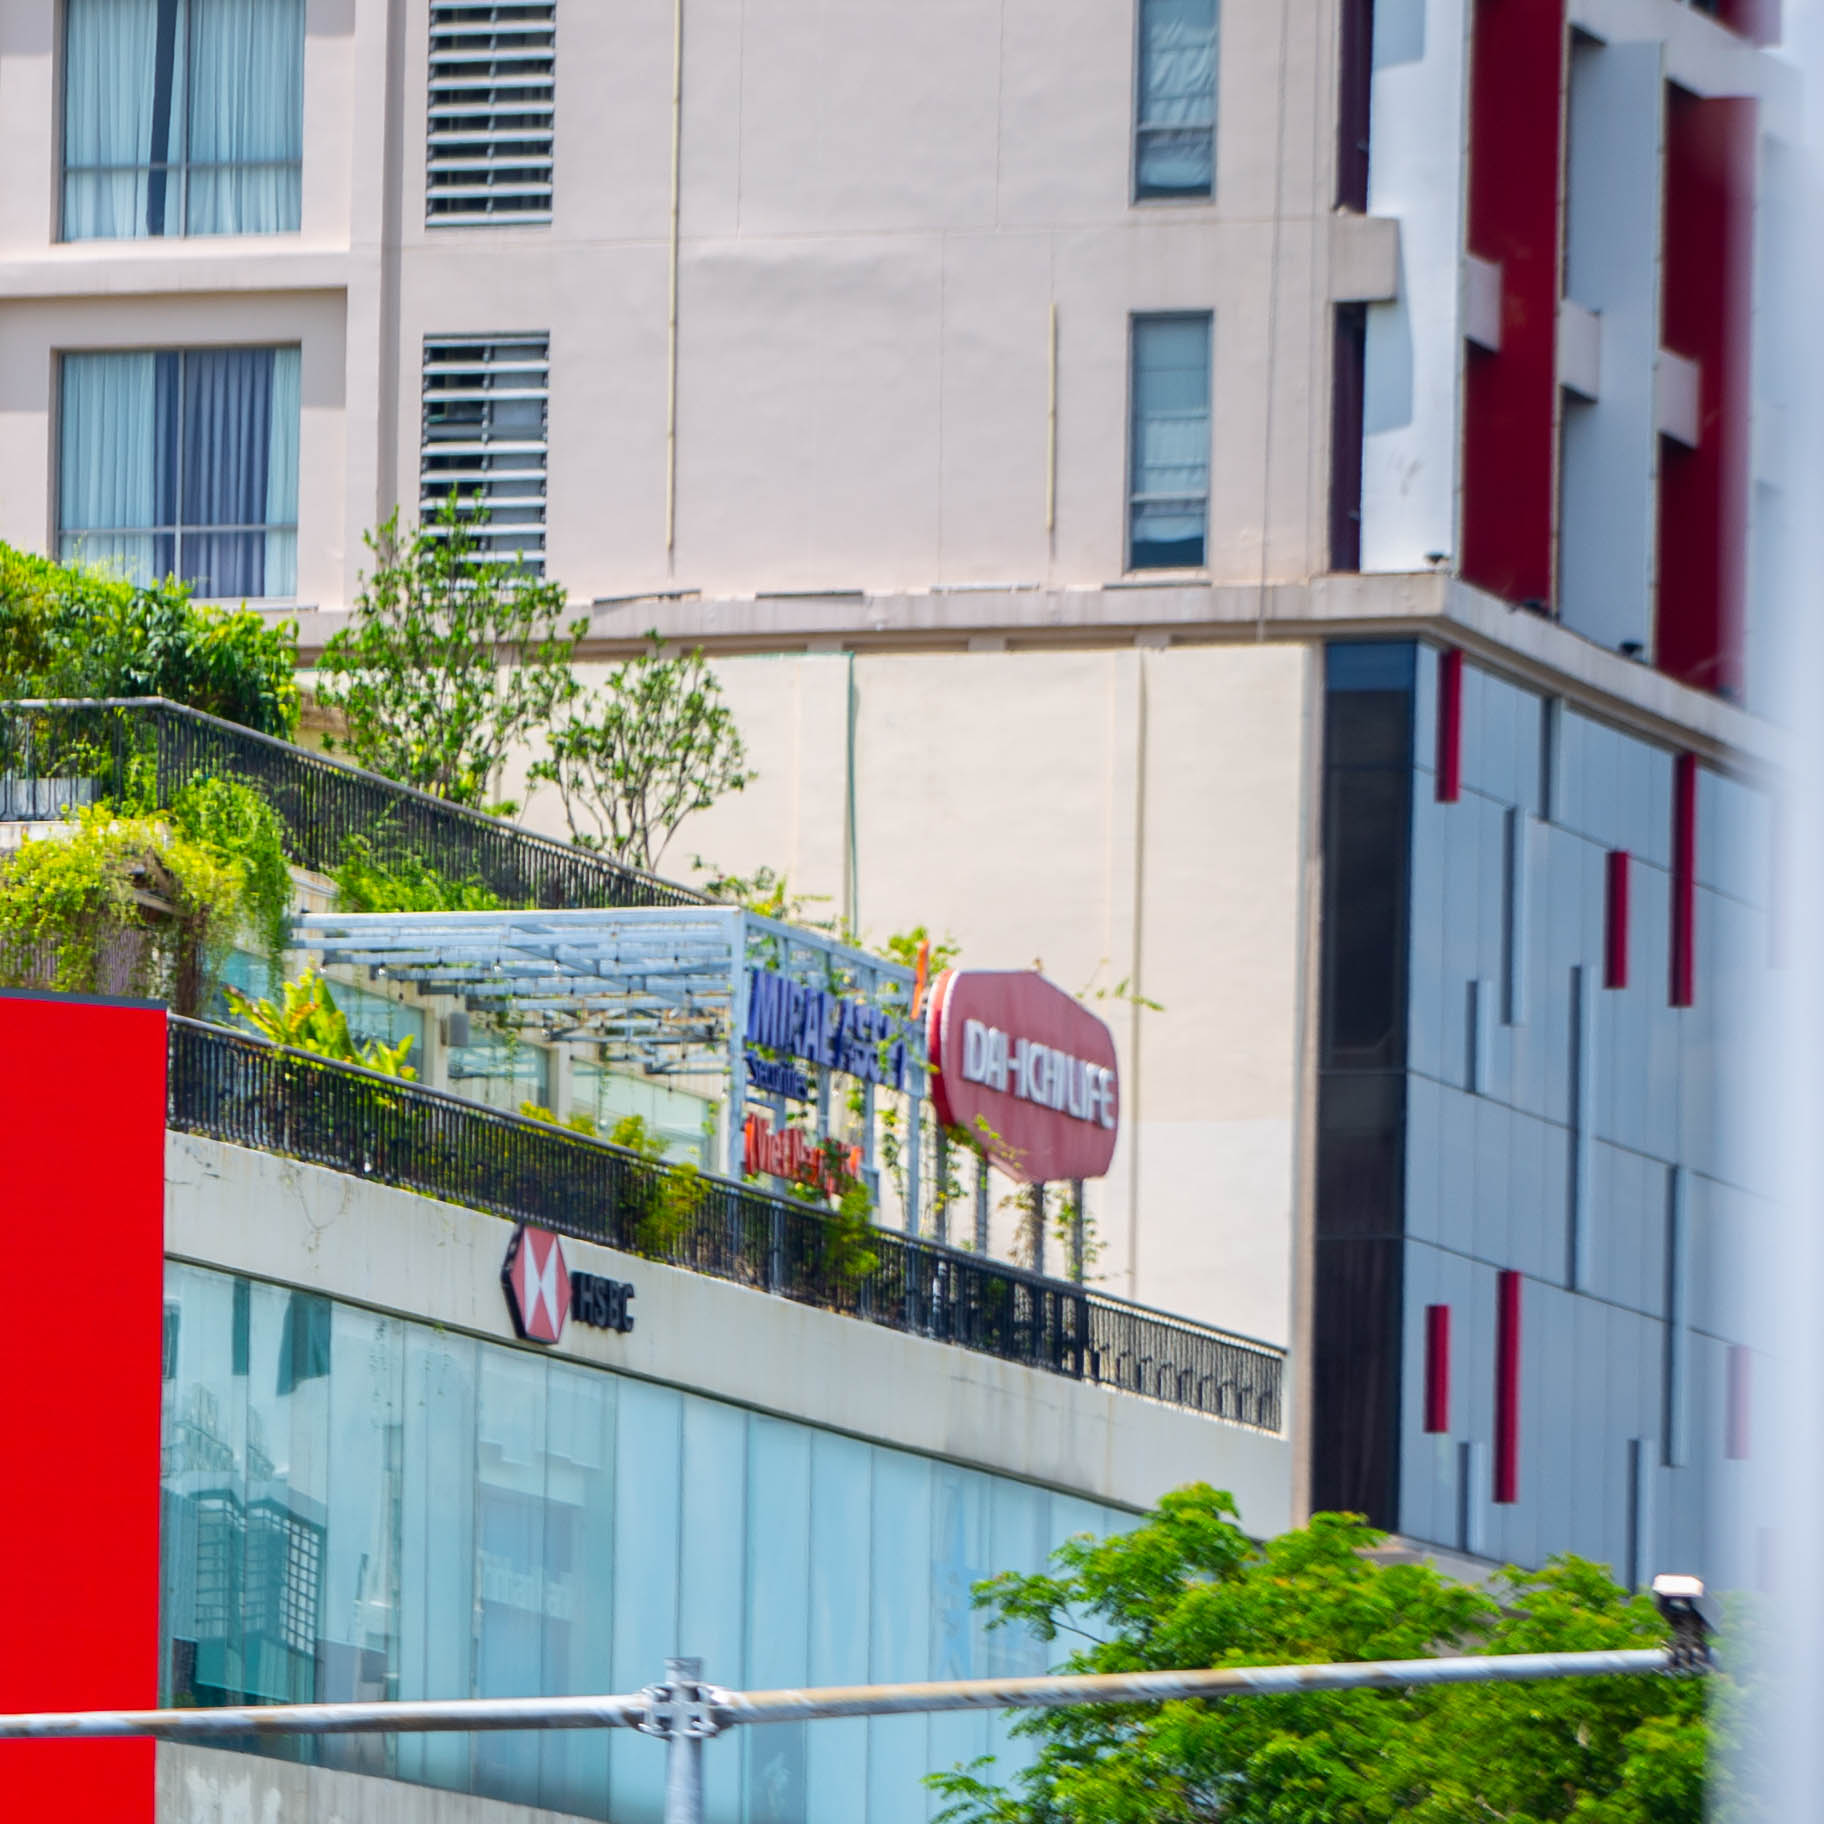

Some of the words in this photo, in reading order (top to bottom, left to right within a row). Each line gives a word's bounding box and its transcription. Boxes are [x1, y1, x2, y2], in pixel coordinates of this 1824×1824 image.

[962, 1018, 1065, 1113] DAI-ICHI
[1063, 1054, 1115, 1131] LIFE
[571, 1270, 635, 1334] HSBC
